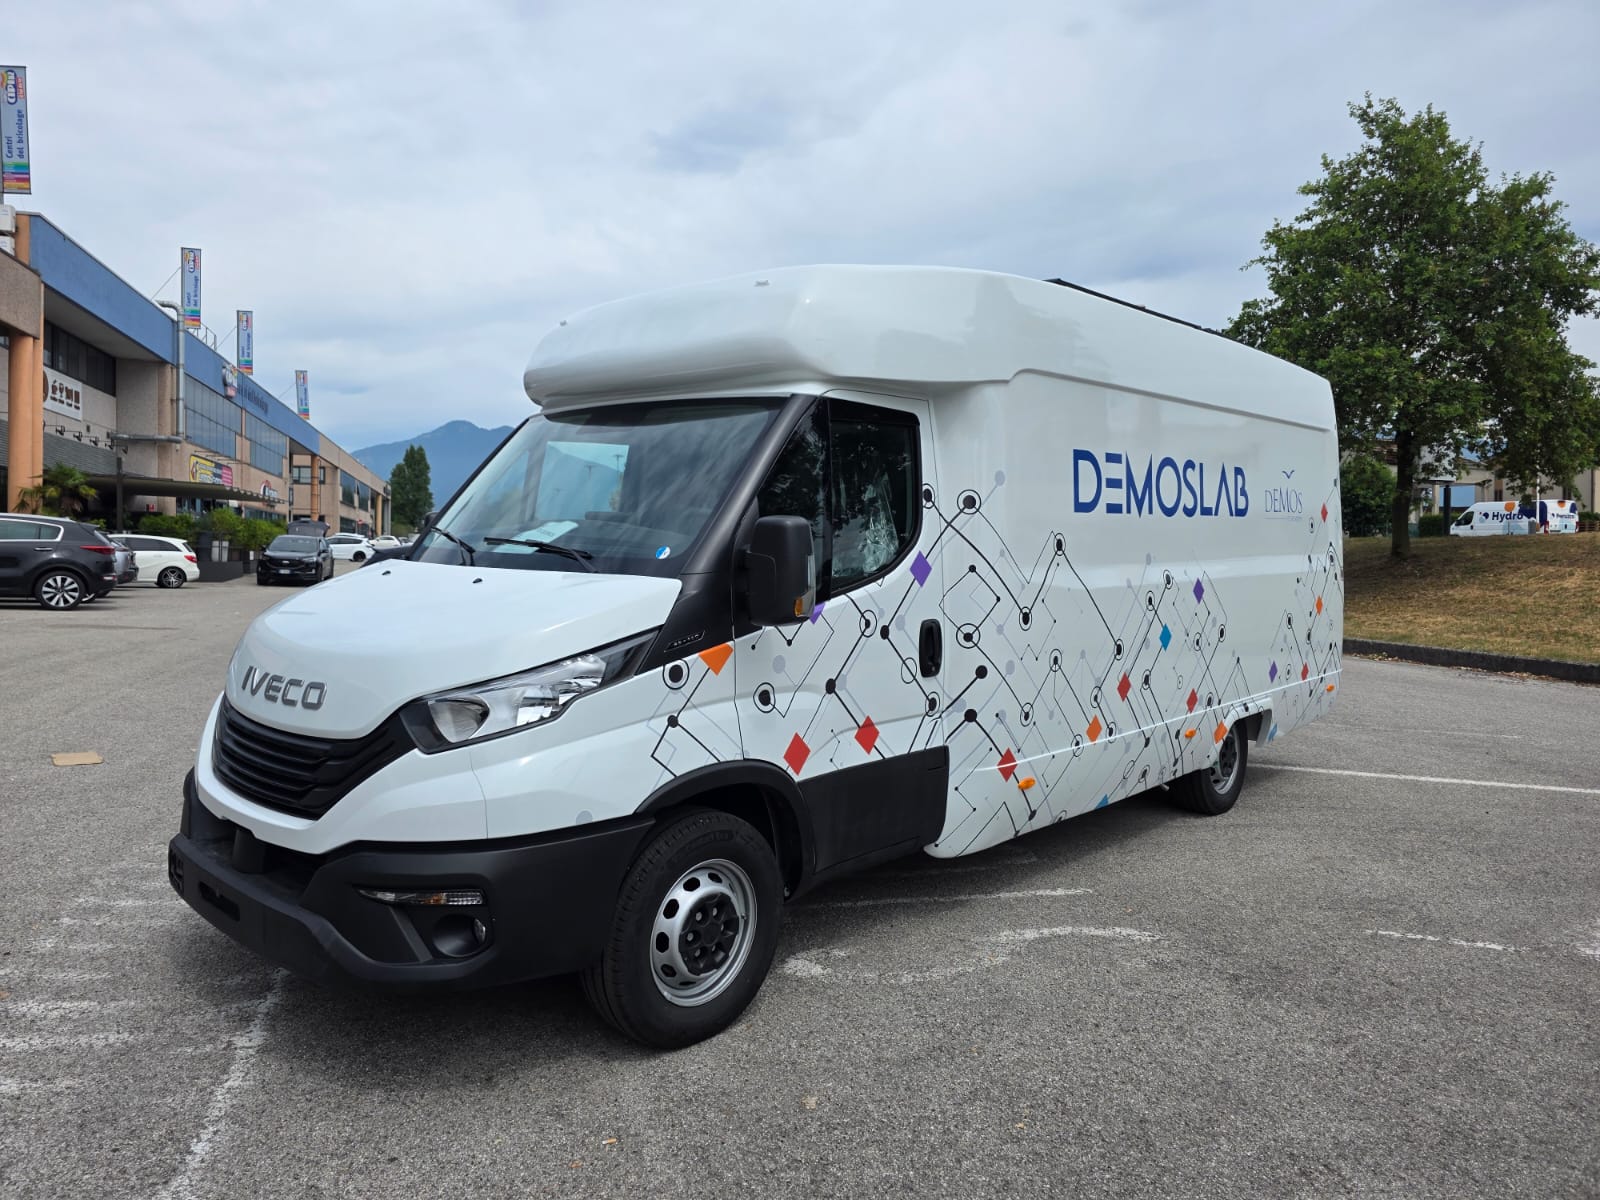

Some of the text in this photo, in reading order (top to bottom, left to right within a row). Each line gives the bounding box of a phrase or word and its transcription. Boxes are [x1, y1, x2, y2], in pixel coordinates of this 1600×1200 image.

[16, 109, 25, 144] bricolage
[5, 136, 13, 159] Centri
[16, 147, 24, 159] del
[1073, 449, 1249, 518] DEMOSLAB
[1264, 486, 1303, 514] DEMOS
[1491, 511, 1524, 523] Hydro
[241, 665, 328, 711] IVECO
